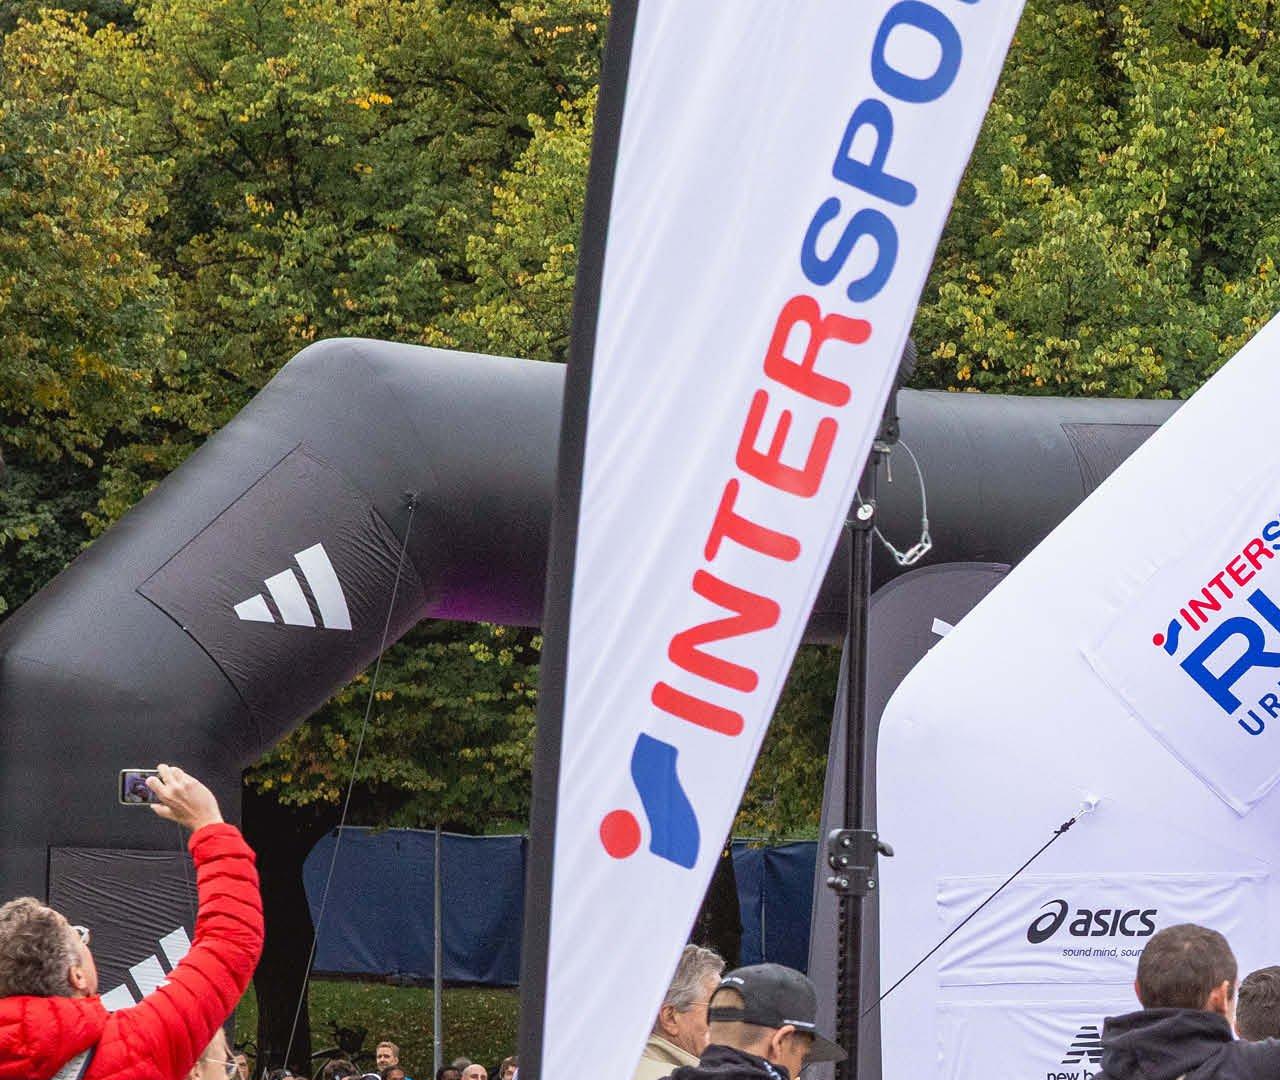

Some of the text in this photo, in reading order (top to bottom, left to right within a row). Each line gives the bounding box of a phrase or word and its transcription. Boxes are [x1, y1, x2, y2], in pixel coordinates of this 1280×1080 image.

[651, 0, 982, 737] INTERSPO
[1069, 909, 1158, 937] asics
[1062, 947, 1092, 957] sound
[1120, 949, 1144, 958] soun
